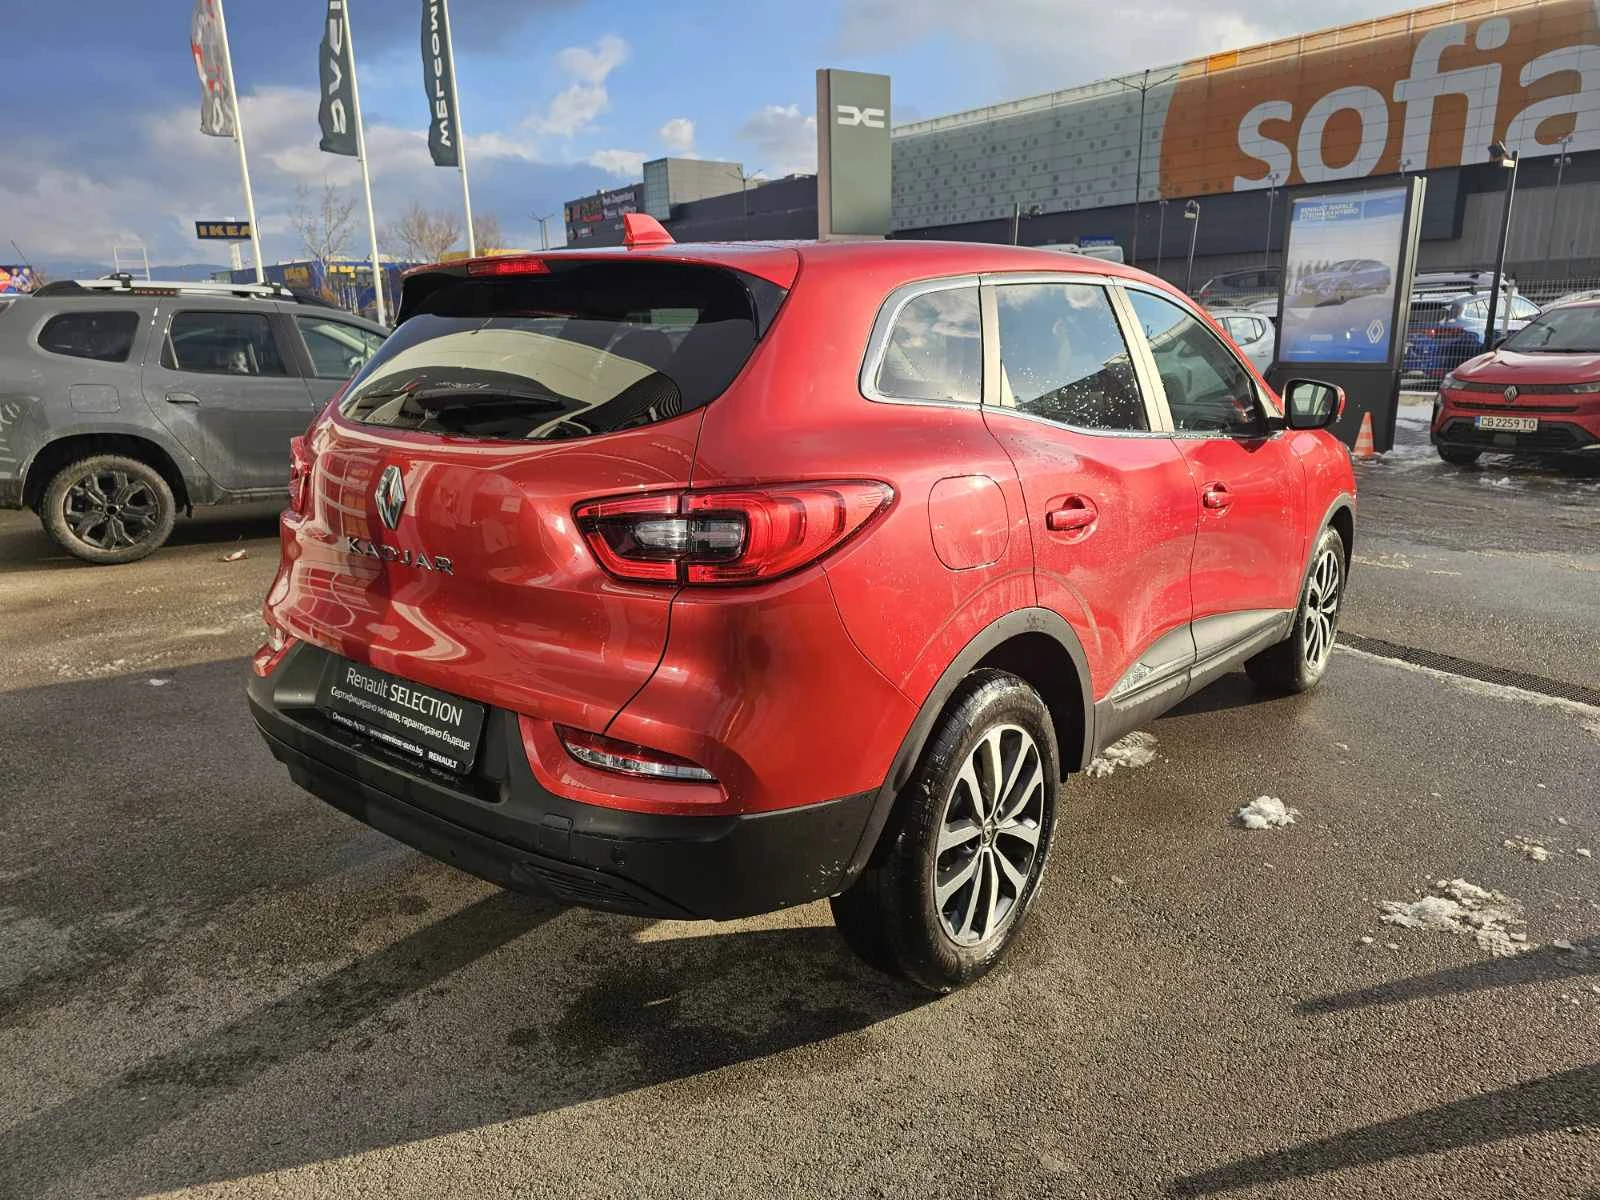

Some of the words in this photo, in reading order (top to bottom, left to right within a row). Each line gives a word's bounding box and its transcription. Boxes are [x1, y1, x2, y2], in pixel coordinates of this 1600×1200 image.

[1232, 17, 1600, 192] sofia
[199, 224, 251, 237] IKEA
[1495, 418, 1520, 429] 2259
[346, 536, 454, 576] KADJAR
[346, 667, 388, 699] Renault
[389, 684, 463, 727] SELECTION
[402, 716, 442, 738] гарантирано
[442, 730, 471, 751] бъдеще
[428, 751, 458, 769] RENAULT
